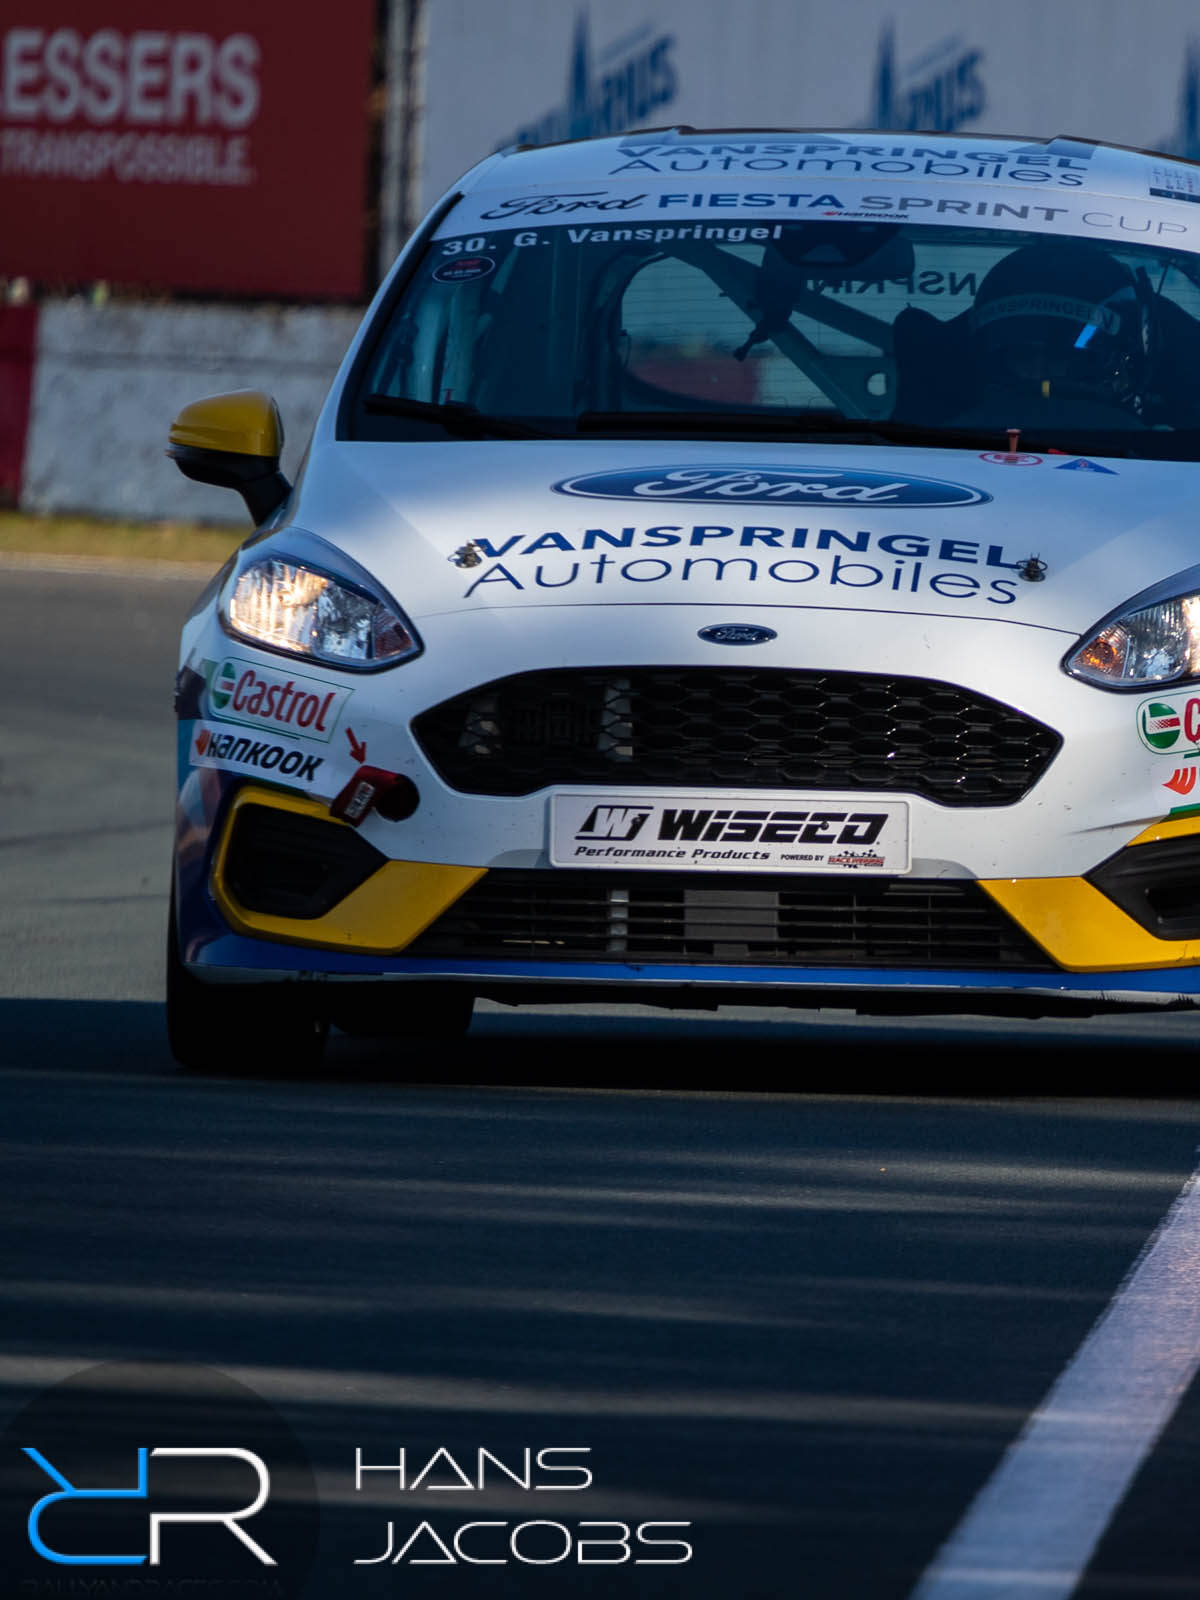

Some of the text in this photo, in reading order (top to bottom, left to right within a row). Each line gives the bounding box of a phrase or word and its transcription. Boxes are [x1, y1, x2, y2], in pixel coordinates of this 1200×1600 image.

[2, 28, 260, 130] ESSERS
[607, 156, 1085, 188] Automobiles
[616, 144, 1090, 172] VANSPRINGEL
[479, 191, 1188, 236] Ford FIESTA SPRINT CUP
[441, 225, 783, 256] 30. G. Vanspringel
[634, 467, 902, 502] Ford
[474, 525, 1020, 569] VANSPRINGEL
[464, 554, 1017, 605] Automobiles
[233, 670, 336, 731] Castrol
[574, 846, 770, 861] Performance Products
